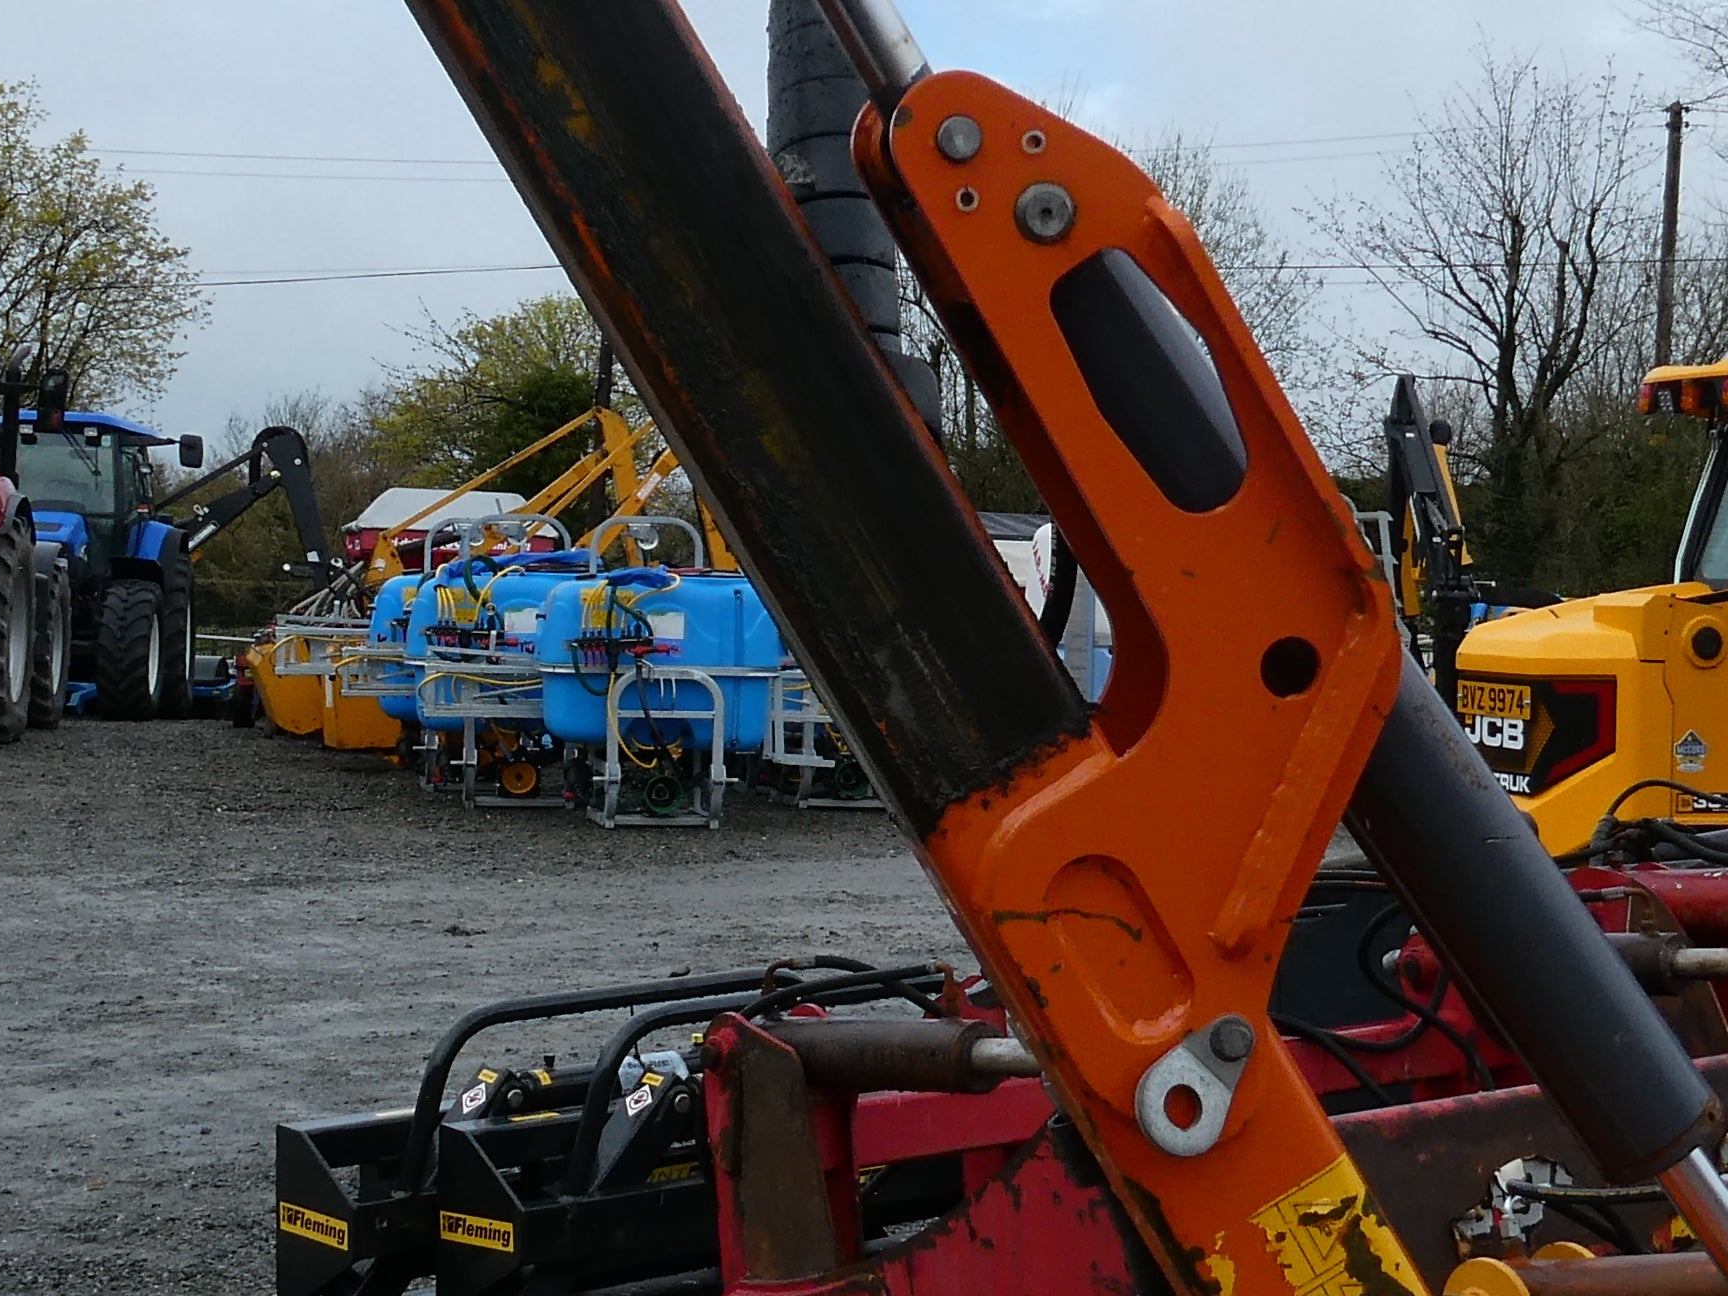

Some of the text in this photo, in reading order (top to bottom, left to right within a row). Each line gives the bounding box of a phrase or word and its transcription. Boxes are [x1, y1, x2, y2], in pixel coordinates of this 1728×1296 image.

[1462, 685, 1525, 715] BVZ 9974
[1464, 715, 1524, 750] JCB
[293, 1210, 346, 1245] Fleming
[454, 1217, 512, 1247] Fleming
